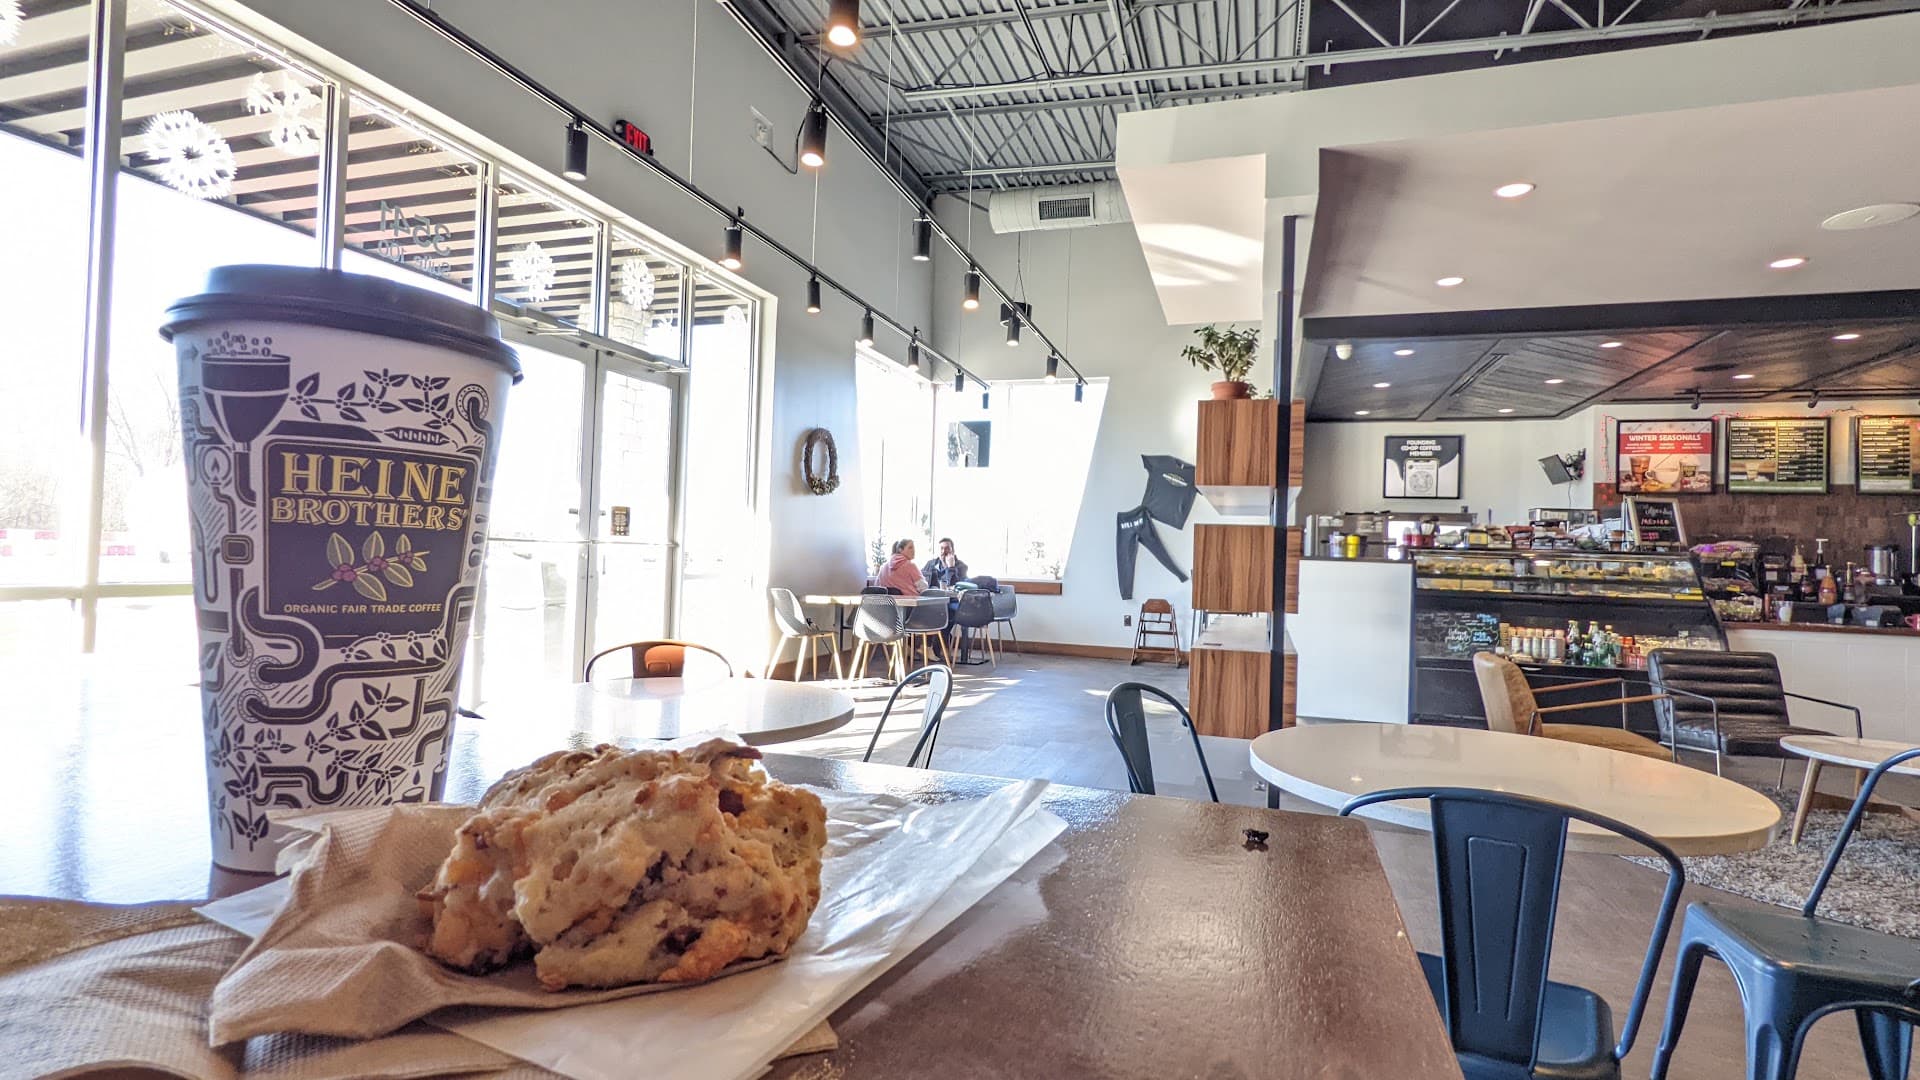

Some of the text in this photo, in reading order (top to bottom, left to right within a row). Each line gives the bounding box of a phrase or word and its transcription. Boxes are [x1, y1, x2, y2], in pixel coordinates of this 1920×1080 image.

[626, 123, 649, 154] EXIT
[280, 451, 467, 504] HEINE
[271, 496, 468, 531] BROTHERS'
[284, 603, 442, 613] ORGANIC FAIR TRADE COFFEE
